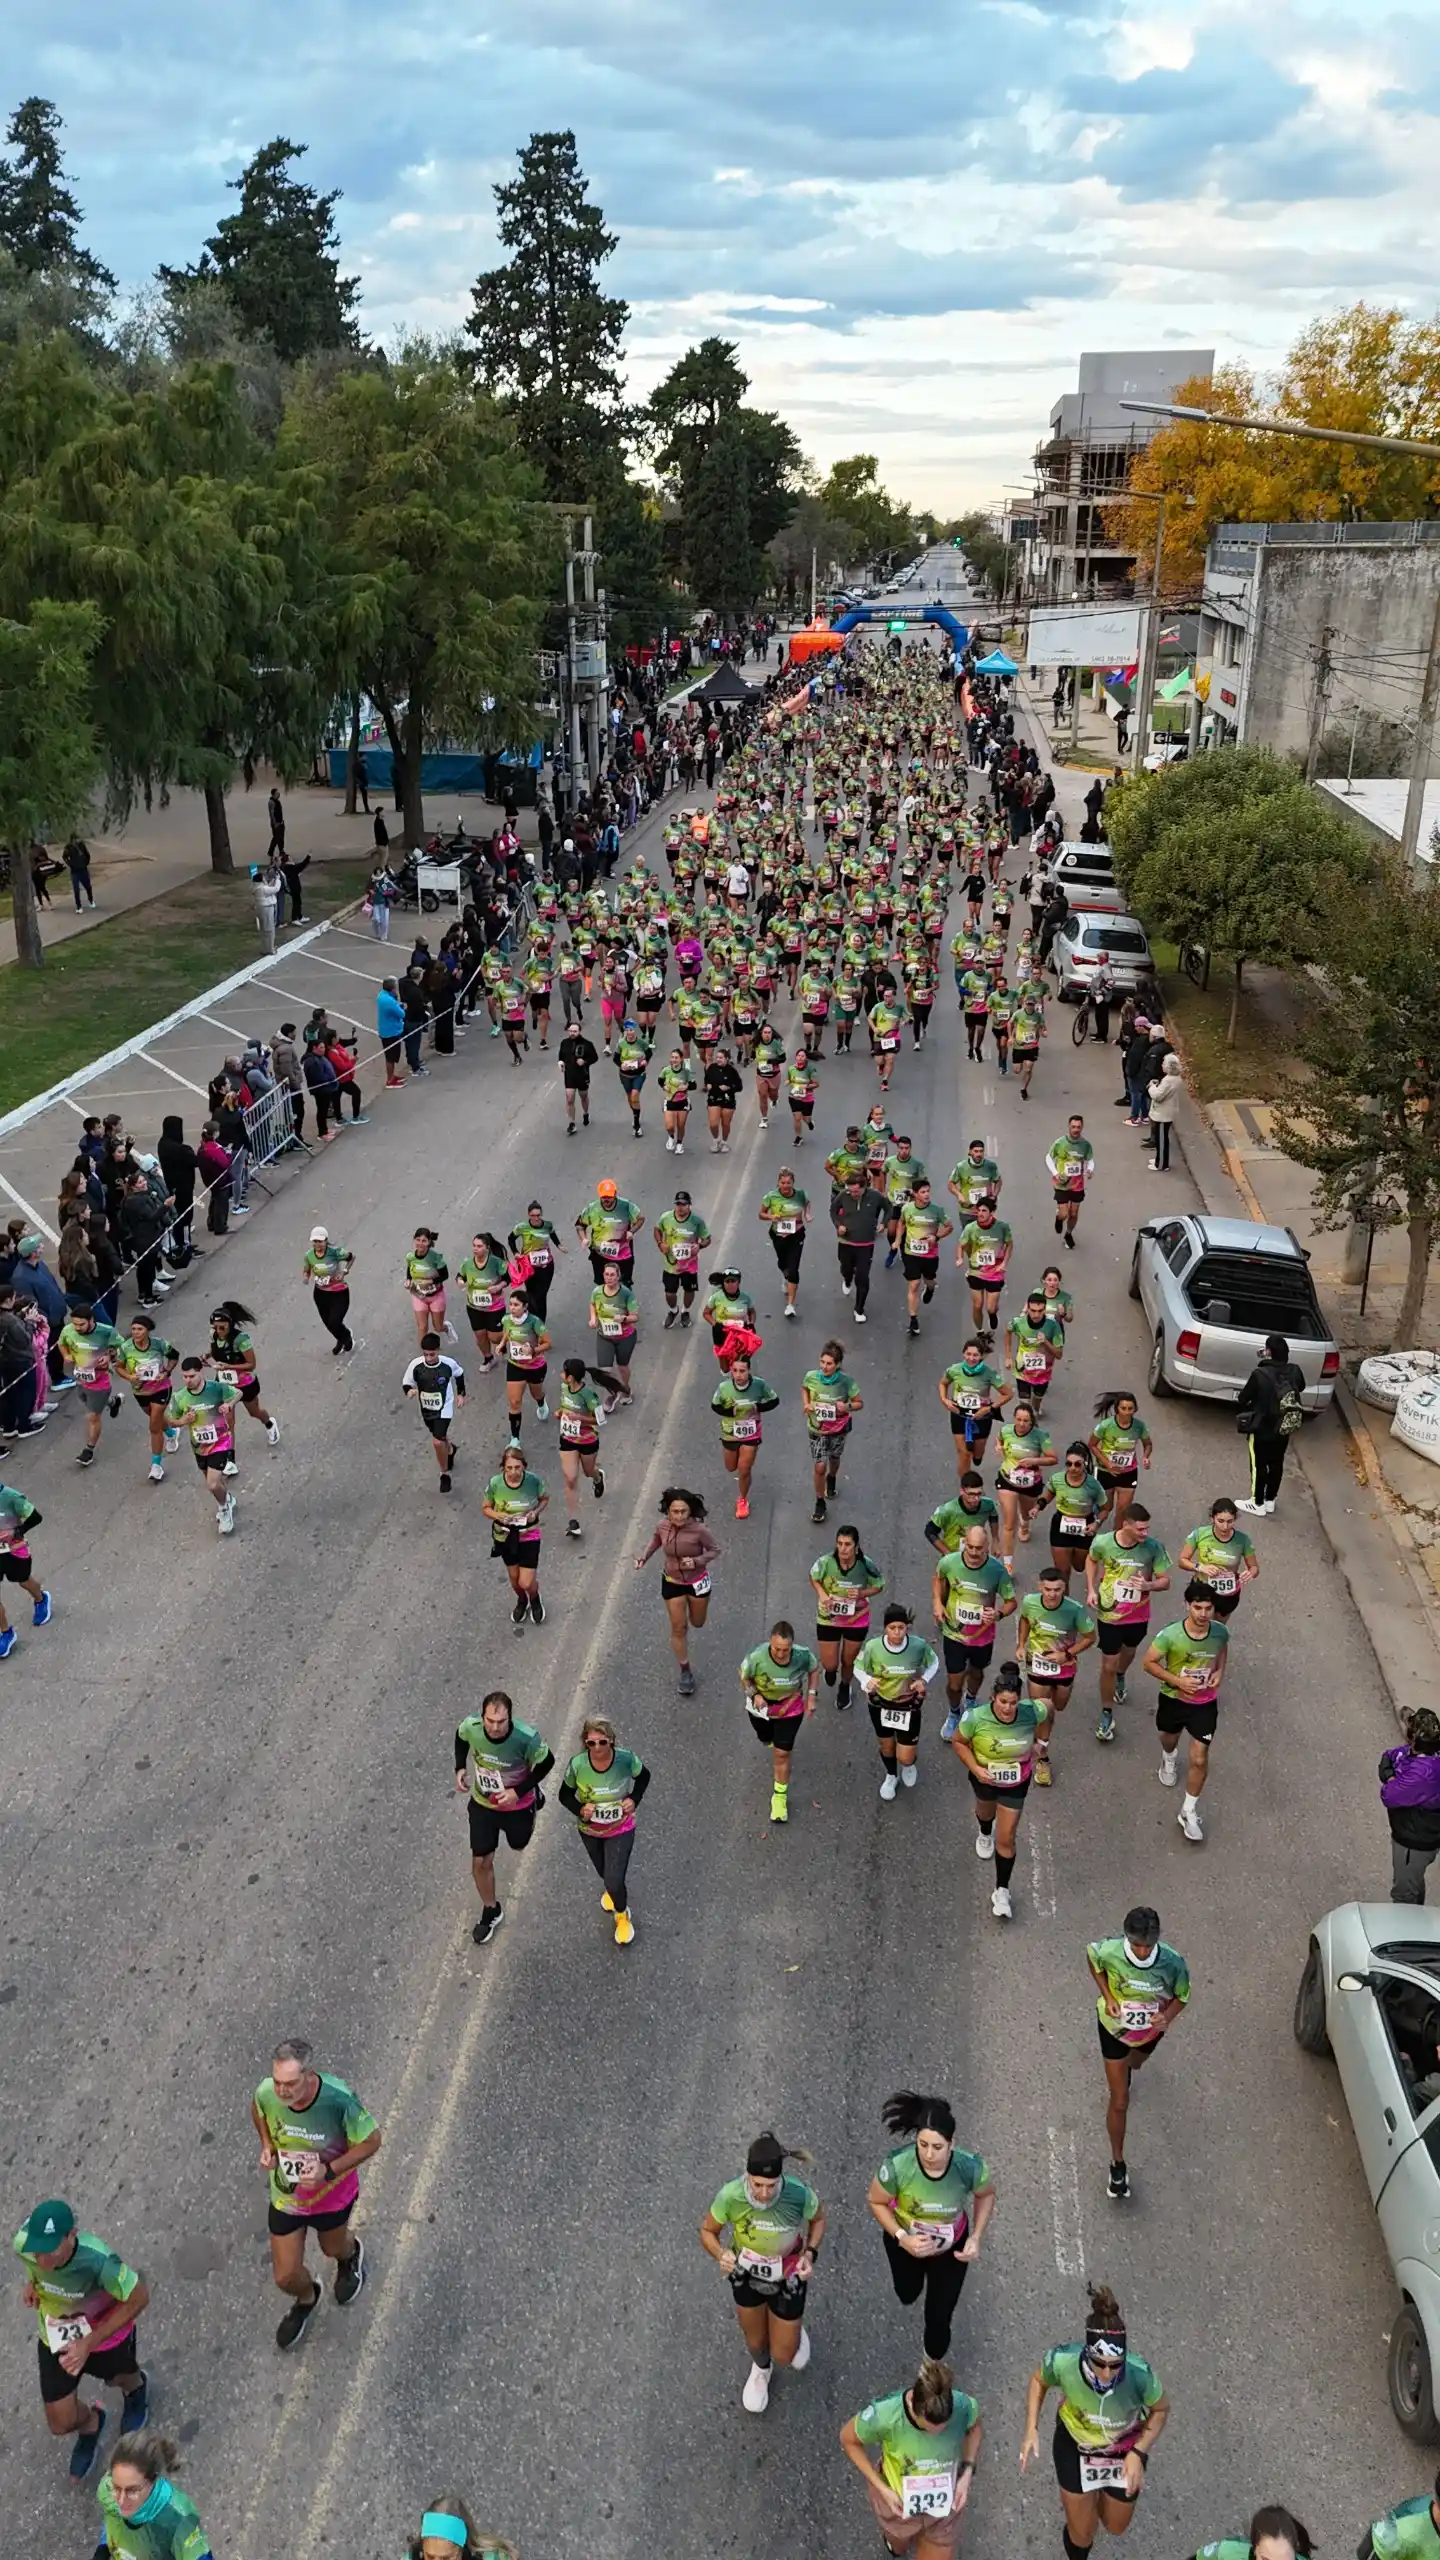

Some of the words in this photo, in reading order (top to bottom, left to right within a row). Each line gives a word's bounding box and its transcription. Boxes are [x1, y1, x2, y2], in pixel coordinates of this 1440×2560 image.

[1025, 1358, 1043, 1368] 222
[1400, 1402, 1439, 1426] averik
[562, 1423, 578, 1435] 443
[1211, 1580, 1233, 1591] 359
[1122, 1588, 1134, 1599] 71
[884, 1711, 907, 1725] 461
[478, 1773, 500, 1790] 193
[993, 1770, 1017, 1781] 1168
[595, 1808, 619, 1821] 1128
[57, 2323, 85, 2341] 23
[909, 2491, 948, 2517] 332
